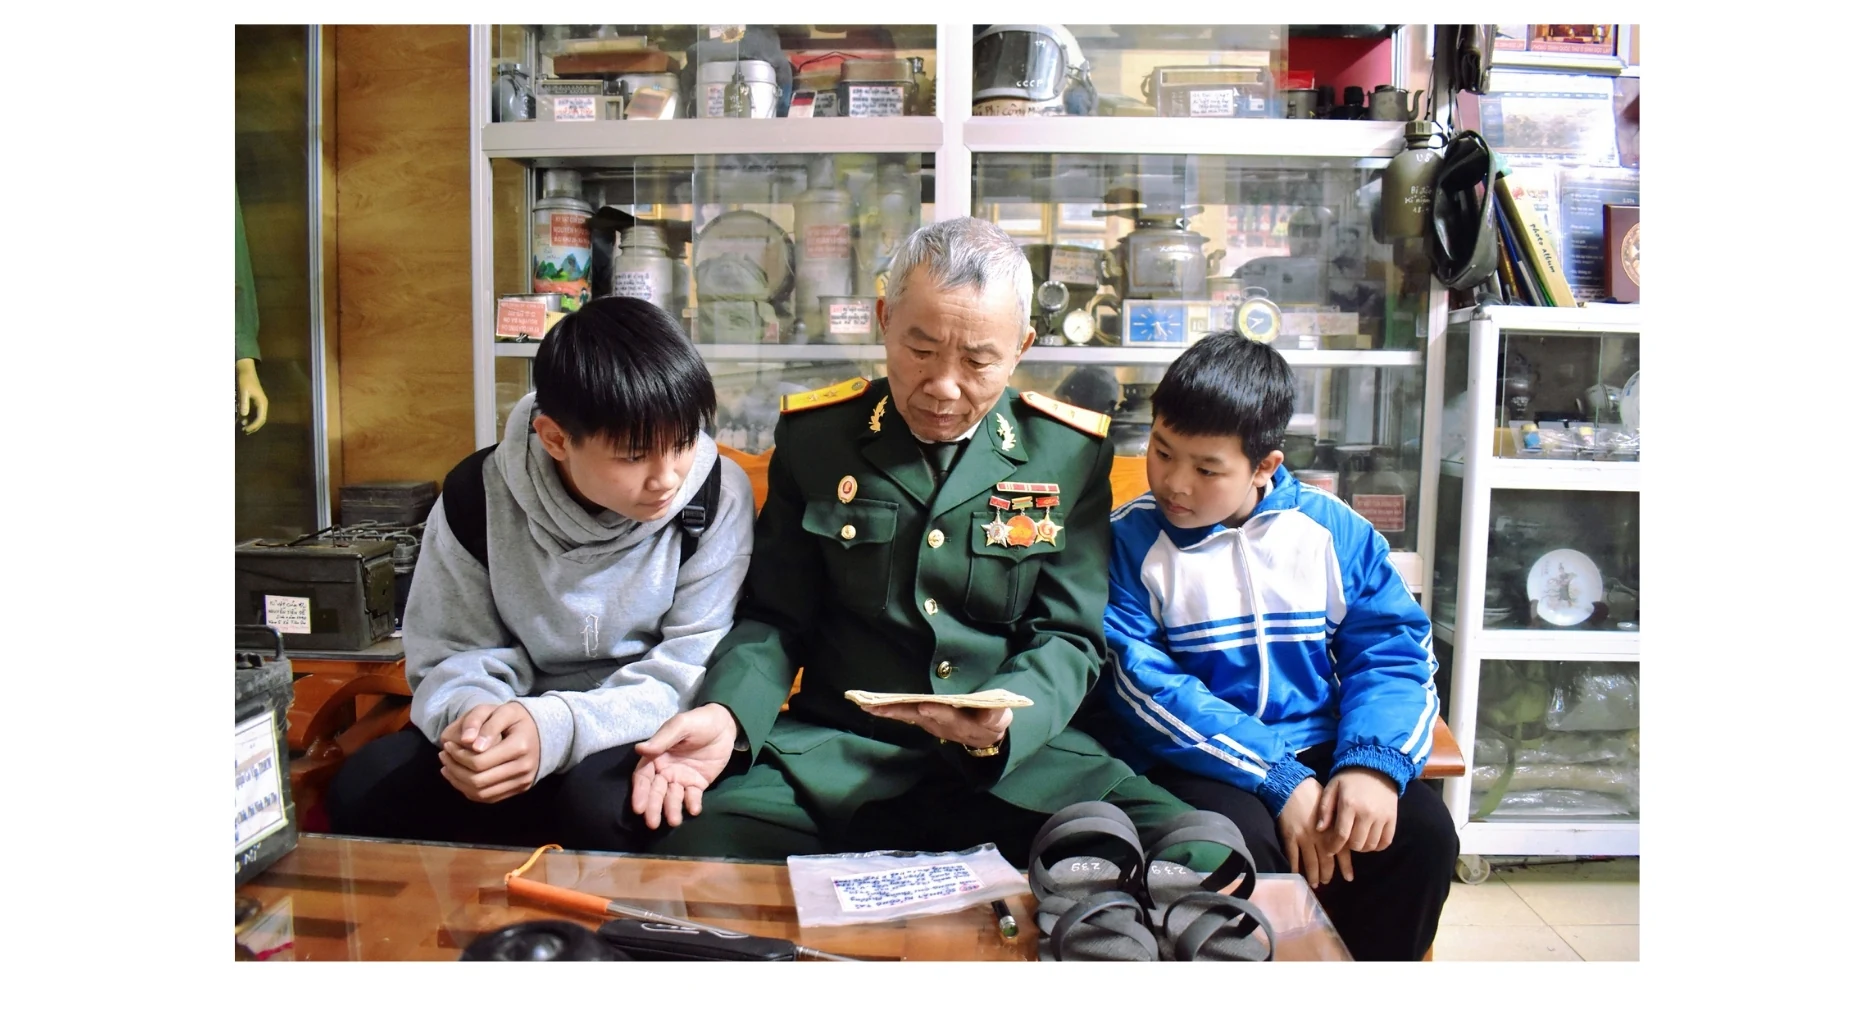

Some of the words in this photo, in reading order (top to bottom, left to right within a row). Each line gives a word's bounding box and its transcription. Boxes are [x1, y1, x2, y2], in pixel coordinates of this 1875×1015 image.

[1529, 223, 1544, 246] photo
[1542, 248, 1555, 273] album
[1071, 862, 1101, 872] 239
[1151, 865, 1187, 875] 239
